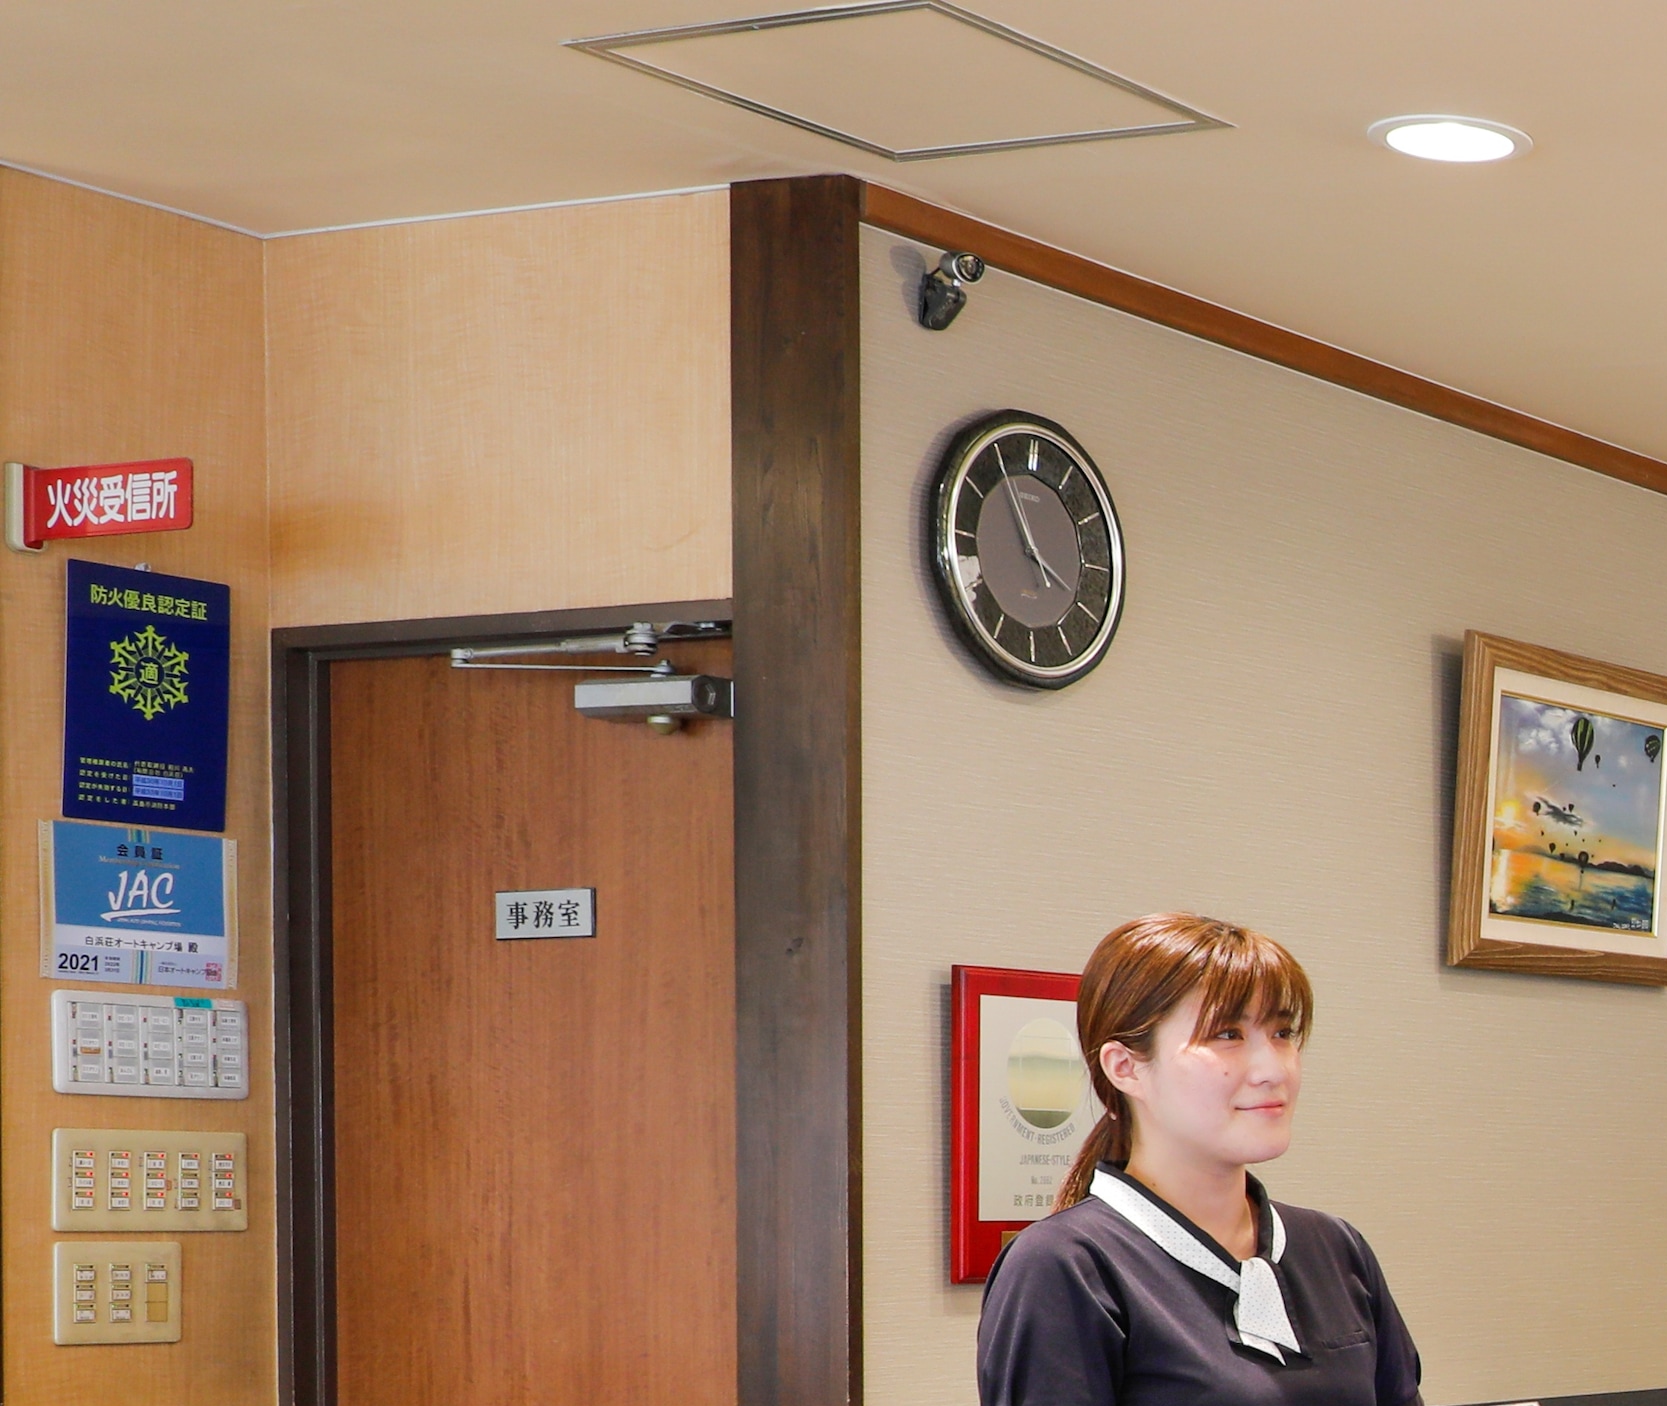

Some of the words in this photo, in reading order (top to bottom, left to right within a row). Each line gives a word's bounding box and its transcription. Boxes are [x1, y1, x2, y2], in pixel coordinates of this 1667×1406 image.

[47, 470, 178, 529] 火災受信所
[90, 583, 208, 621] 防火優良認定証
[139, 660, 161, 686] 適
[116, 843, 163, 861] 会員証
[108, 869, 173, 910] JAC
[506, 900, 580, 930] 事務室
[84, 936, 183, 953] 白浜荘オートキャンプ場
[58, 953, 99, 971] 2021
